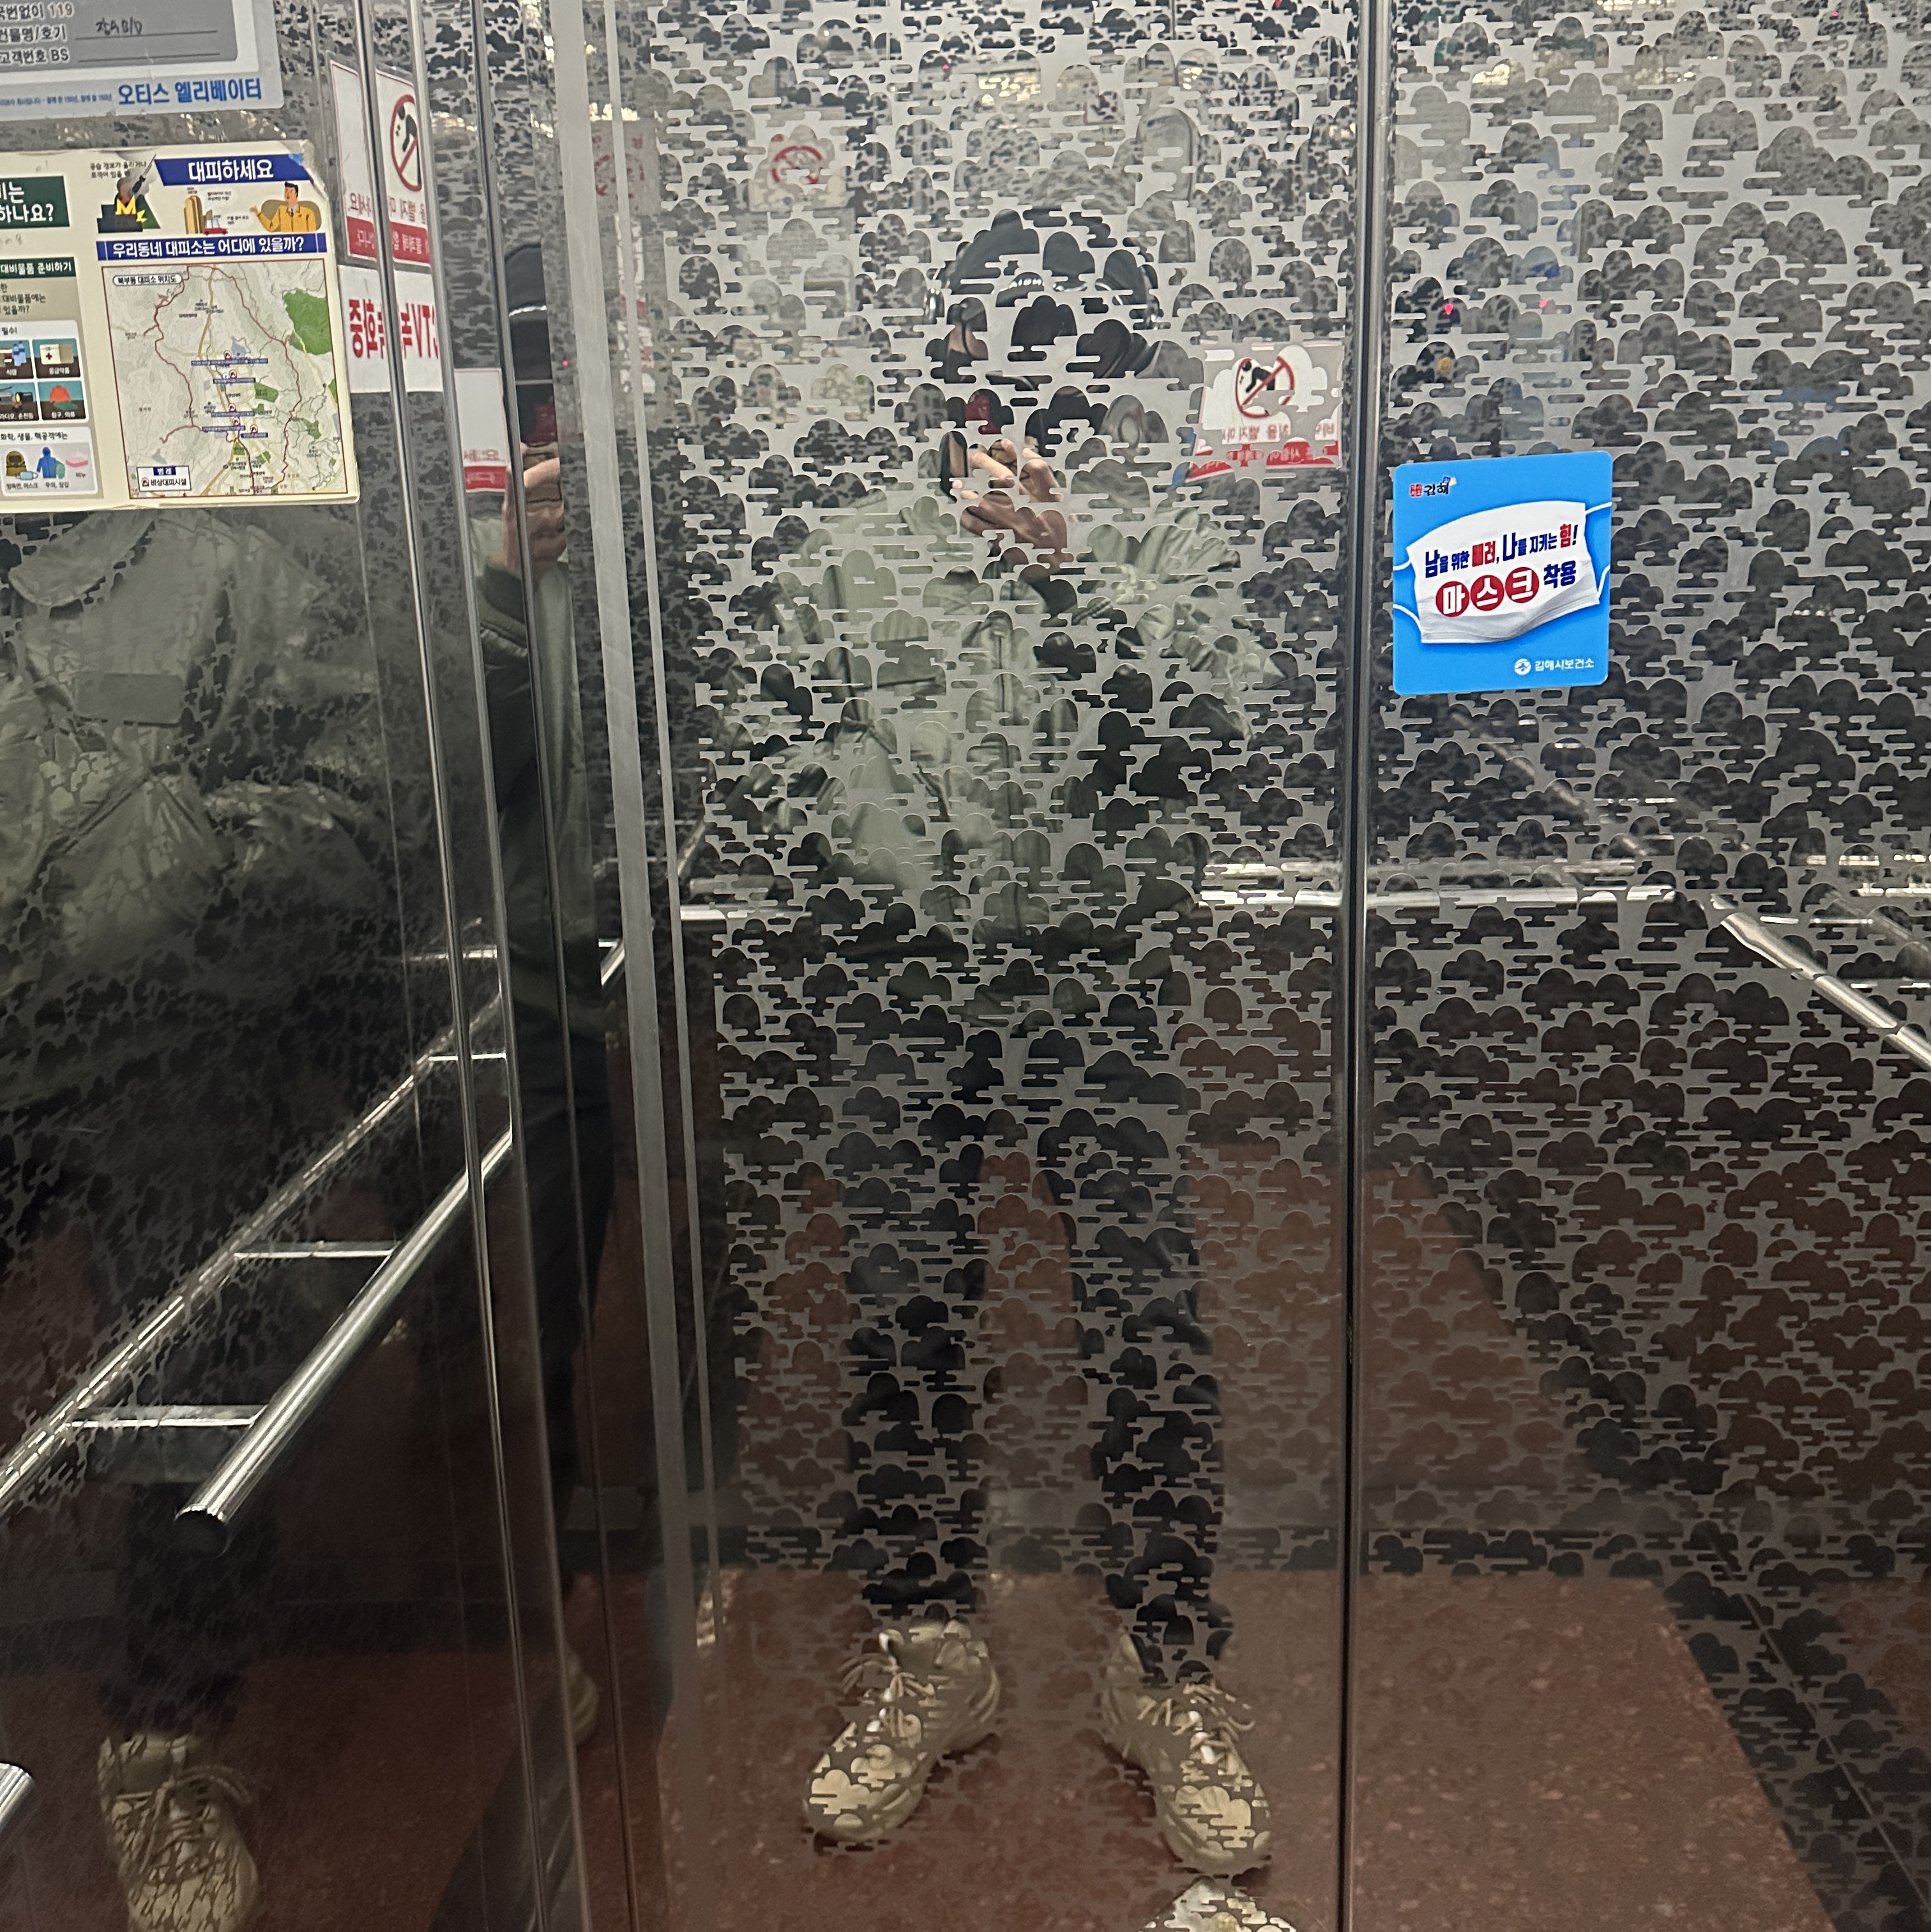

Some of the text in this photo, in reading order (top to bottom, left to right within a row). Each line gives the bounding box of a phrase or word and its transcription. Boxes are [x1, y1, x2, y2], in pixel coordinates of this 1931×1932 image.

[49, 3, 72, 16] 119
[0, 49, 68, 64] 고객번호 BS
[118, 83, 170, 105] 오티스
[175, 78, 262, 103] 엘리베이터
[188, 160, 273, 181] 대피하세요
[0, 204, 54, 223] 하나요?
[113, 236, 304, 257] 우리동네 대피소는 어디에 있을까?
[38, 261, 72, 274] 준비하기
[151, 477, 186, 486] 비상대피시설
[1424, 480, 1449, 496] 김해
[1425, 524, 1578, 578] 남을 위한 배려, 나를 지키는 힘!
[1441, 560, 1577, 615] 마스크 착용
[1535, 658, 1594, 671] 김해시보건소
